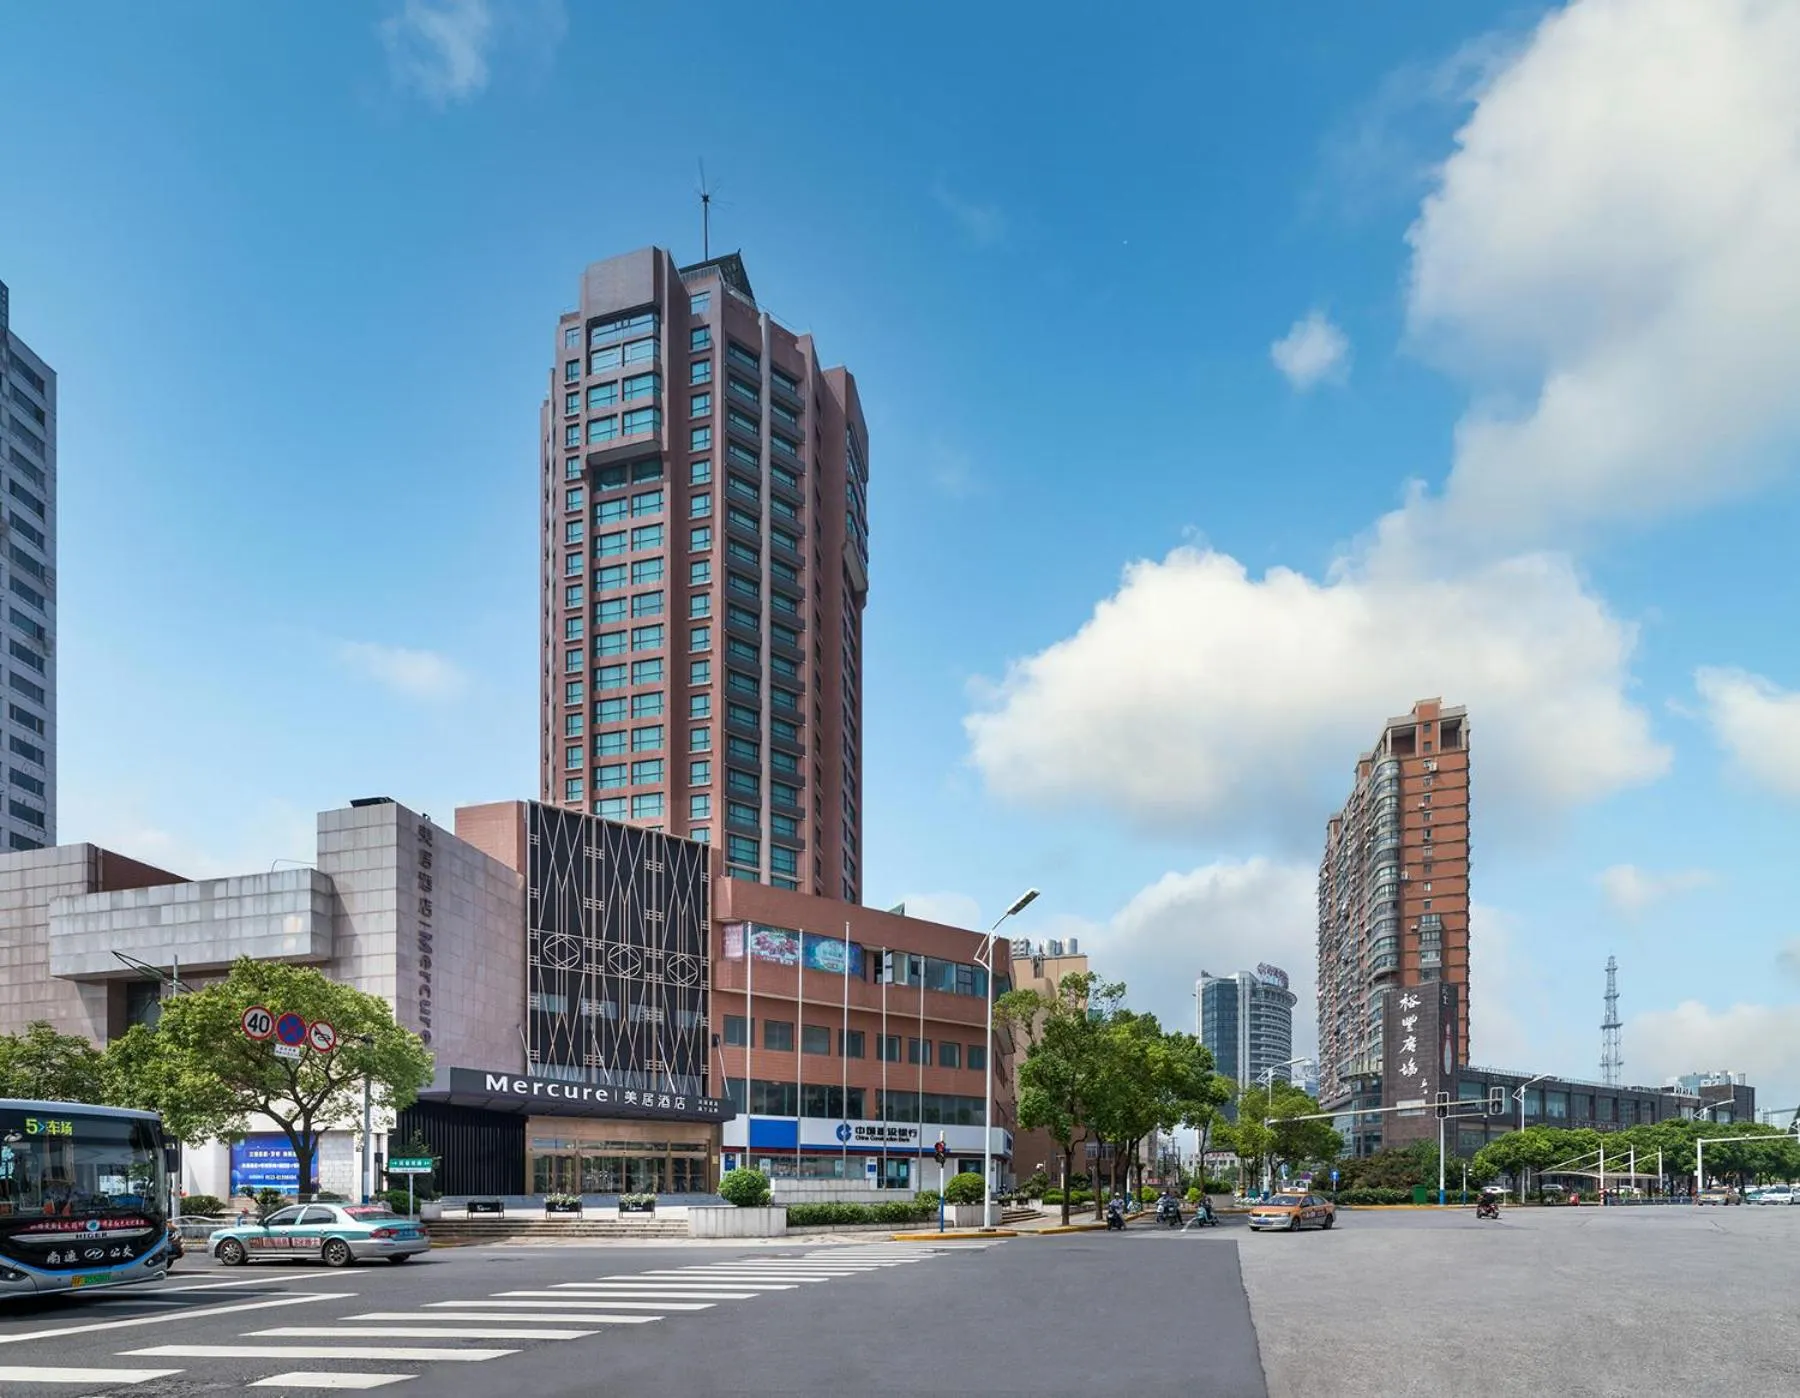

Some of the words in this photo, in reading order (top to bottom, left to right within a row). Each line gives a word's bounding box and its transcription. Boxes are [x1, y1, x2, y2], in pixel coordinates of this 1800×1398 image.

[417, 930, 433, 1046] Mercure
[247, 1013, 270, 1033] 40
[485, 1074, 609, 1102] Mercure
[624, 1090, 686, 1110] 美居酒店
[25, 1118, 38, 1135] 5
[46, 1120, 73, 1135] 车场
[855, 1126, 917, 1138] 中国建设银行
[75, 1232, 108, 1240] HIGER
[46, 1249, 79, 1264] 南通
[110, 1245, 134, 1258] 公交
